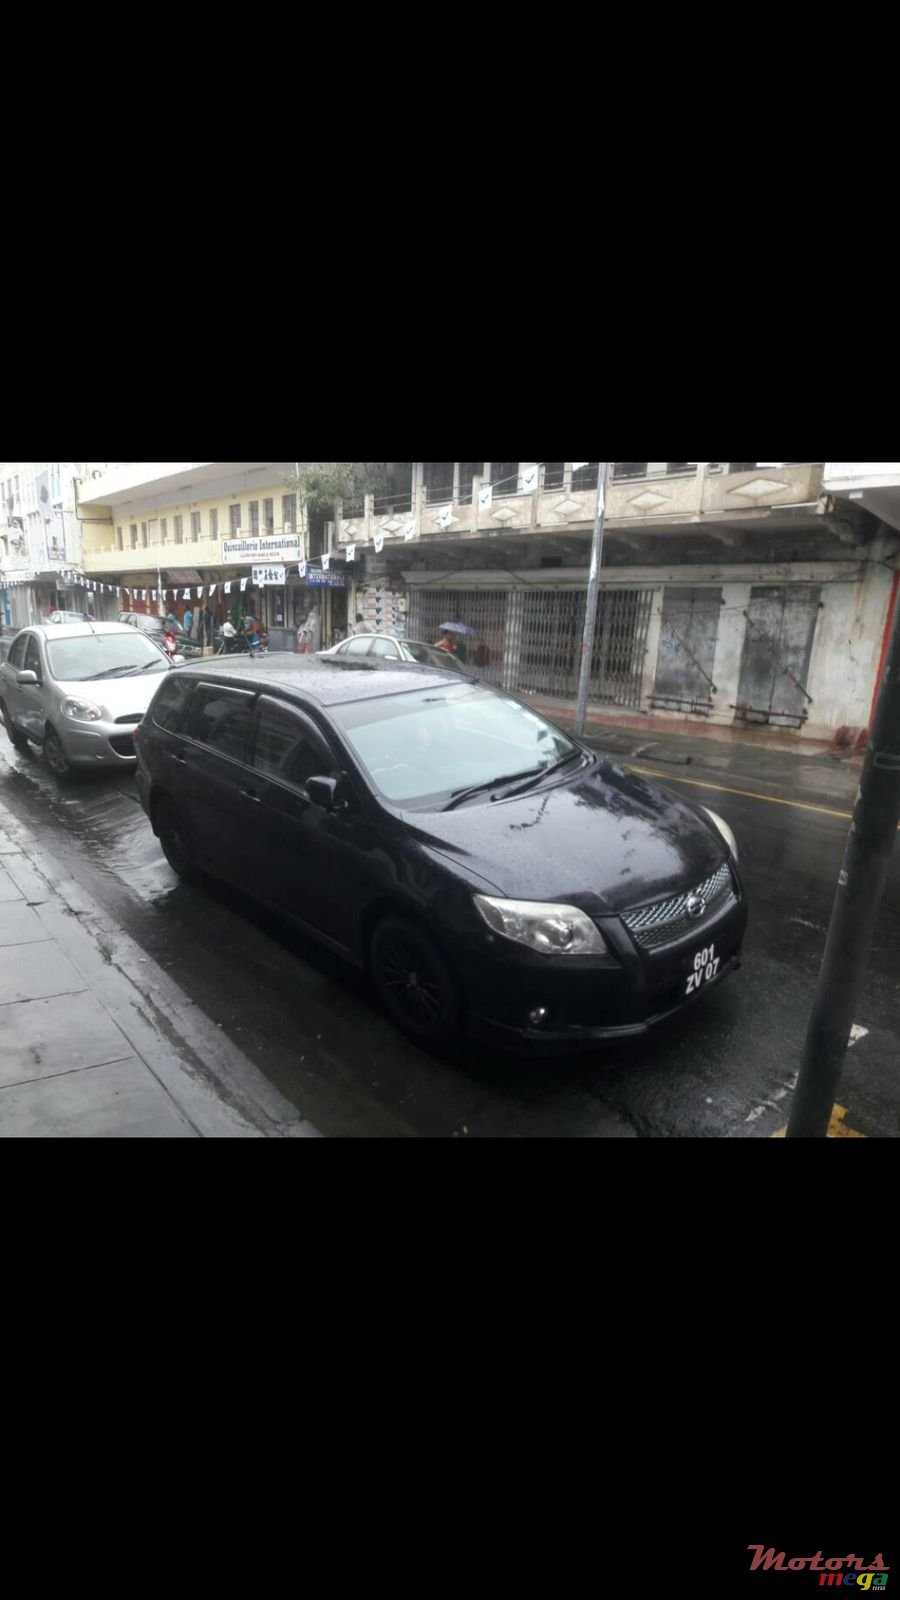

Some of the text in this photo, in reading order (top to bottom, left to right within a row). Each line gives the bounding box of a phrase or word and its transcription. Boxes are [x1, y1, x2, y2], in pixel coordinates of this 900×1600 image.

[223, 536, 300, 552] Quincaillerie International
[694, 943, 714, 970] 601
[685, 957, 720, 994] ZV 07
